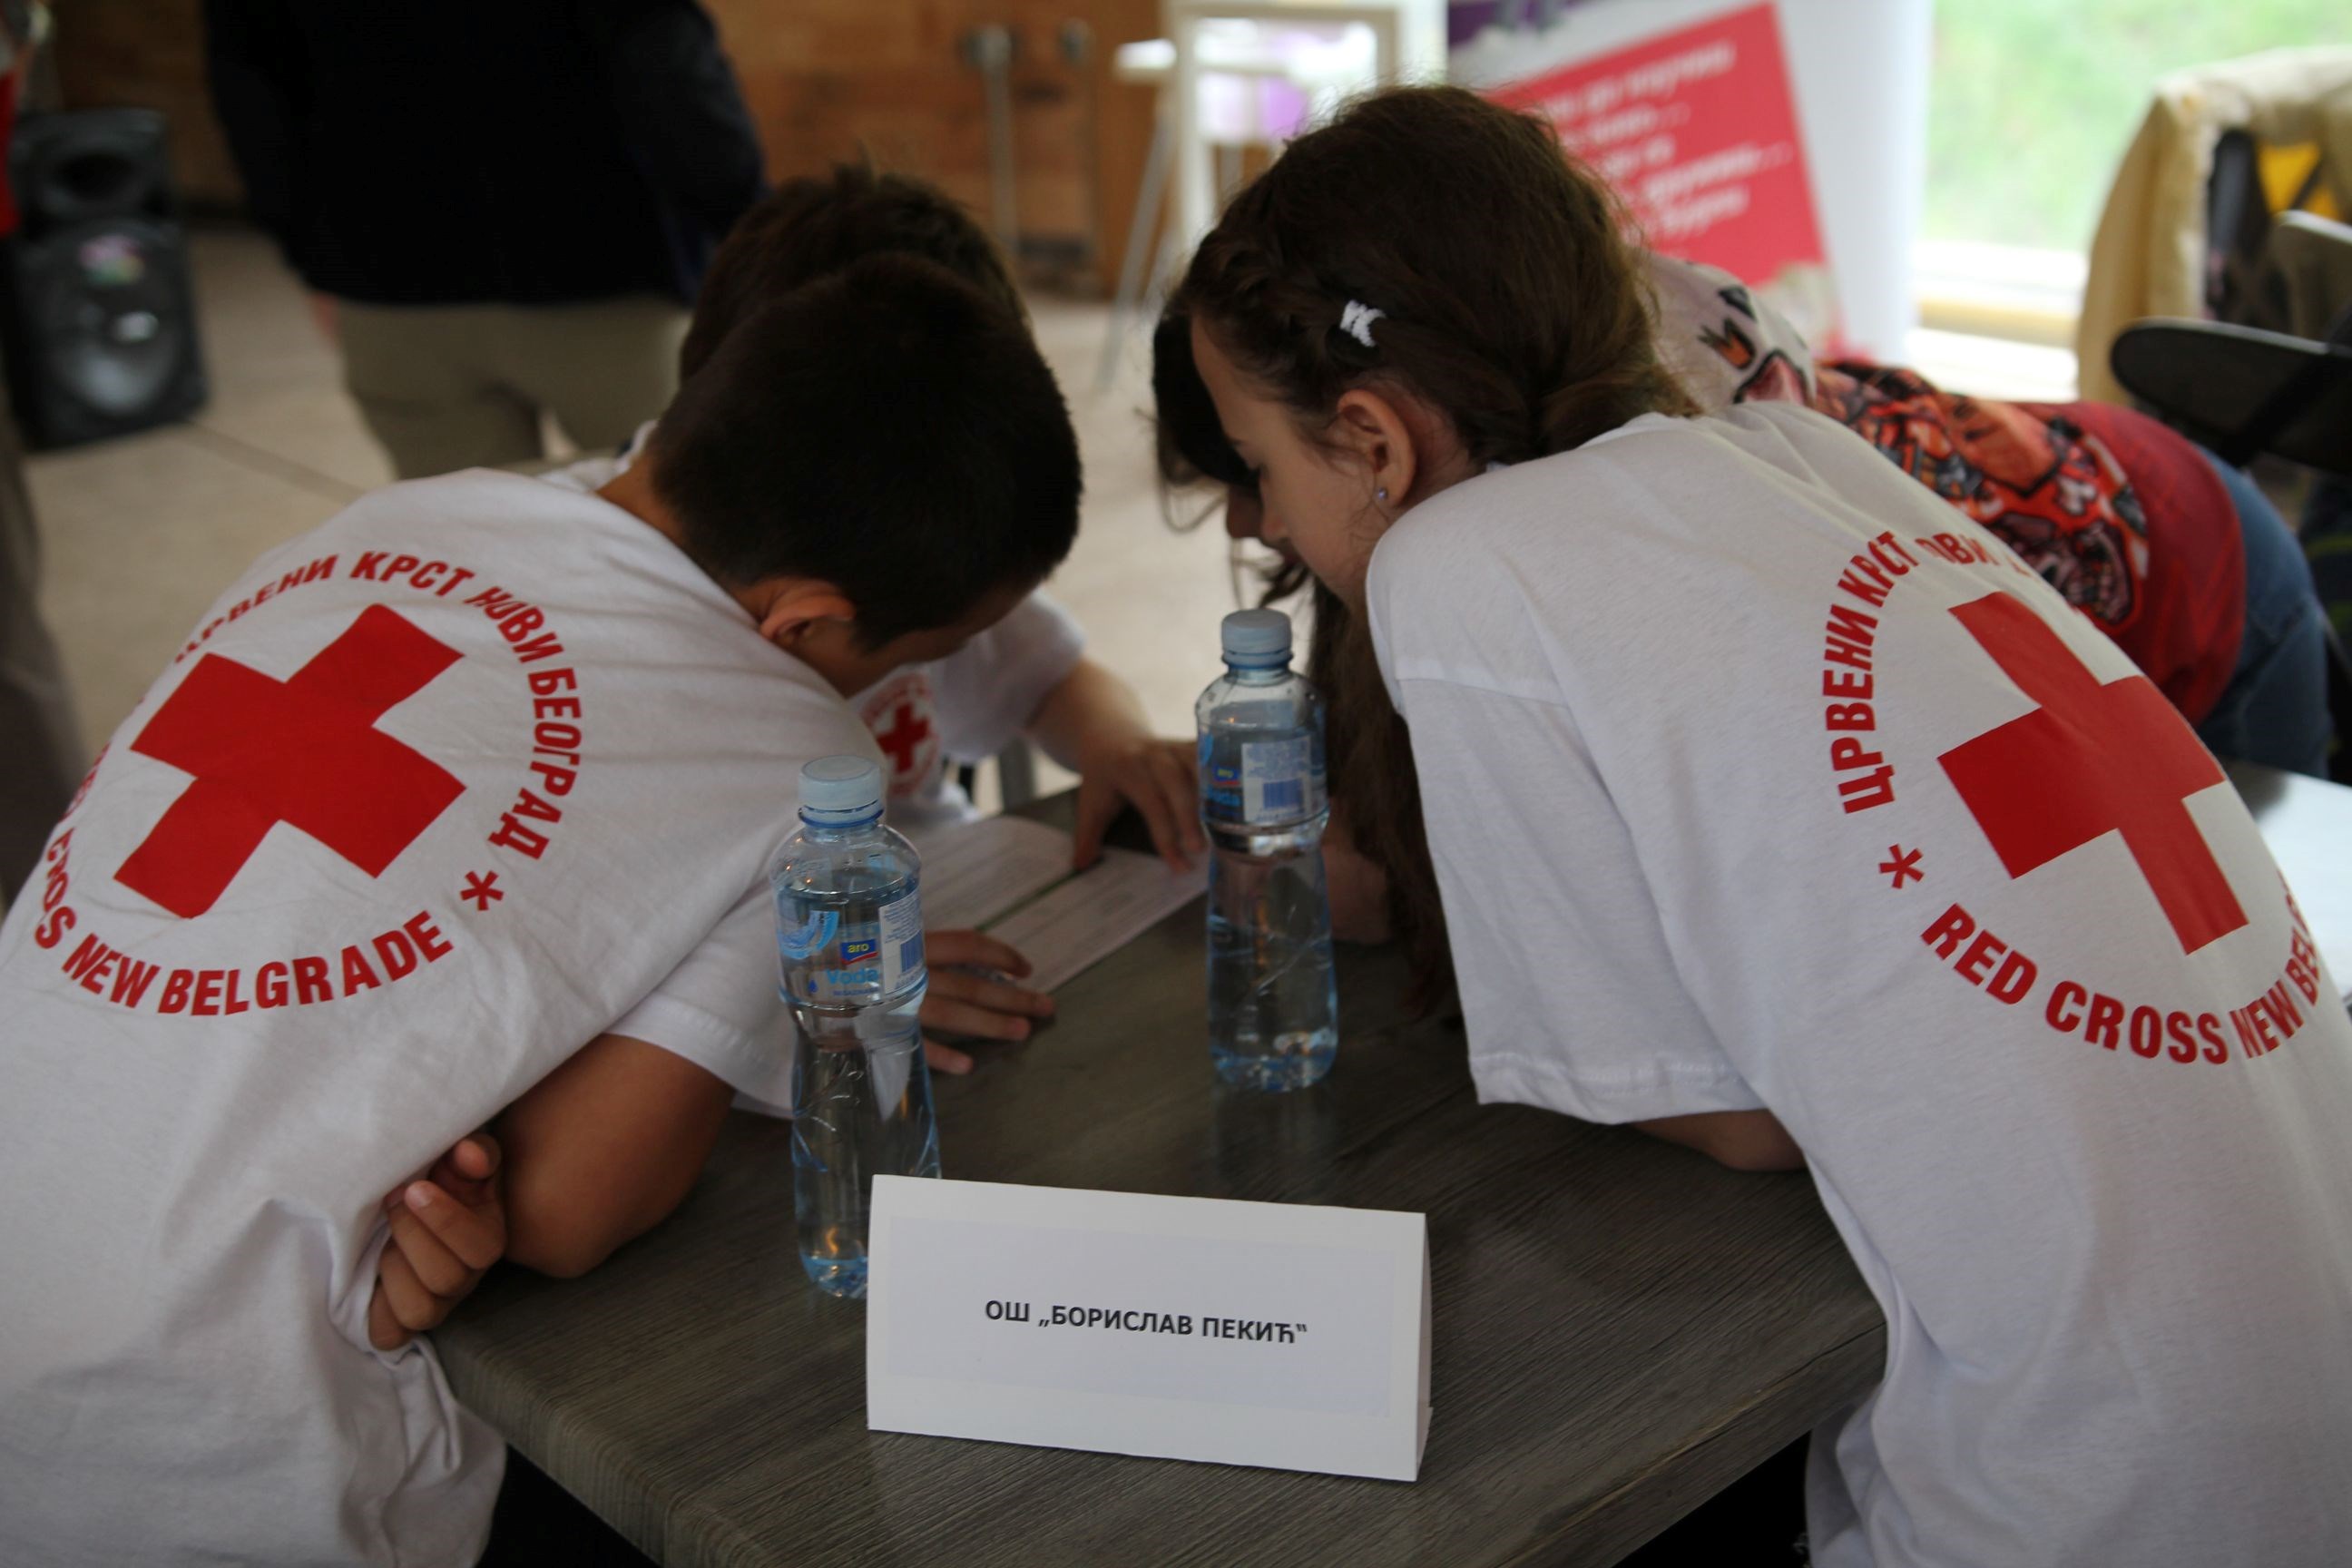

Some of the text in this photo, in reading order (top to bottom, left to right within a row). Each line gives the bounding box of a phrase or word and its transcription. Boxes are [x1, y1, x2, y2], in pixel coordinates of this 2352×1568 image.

[349, 550, 476, 598] КРСТ
[1838, 530, 1919, 609] КРСТ
[462, 585, 565, 664] НОВИ
[1823, 604, 1896, 815] ЦРВЕНИ
[487, 666, 583, 860] БЕОГРАД
[62, 933, 161, 1009] NEW
[157, 910, 454, 1017] BELGRADE
[848, 944, 869, 953] aro
[1920, 903, 2305, 1066] RED CROSS NEW
[985, 1299, 1030, 1323] ОШ
[1038, 1305, 1193, 1336] „БОРИСЛАВ
